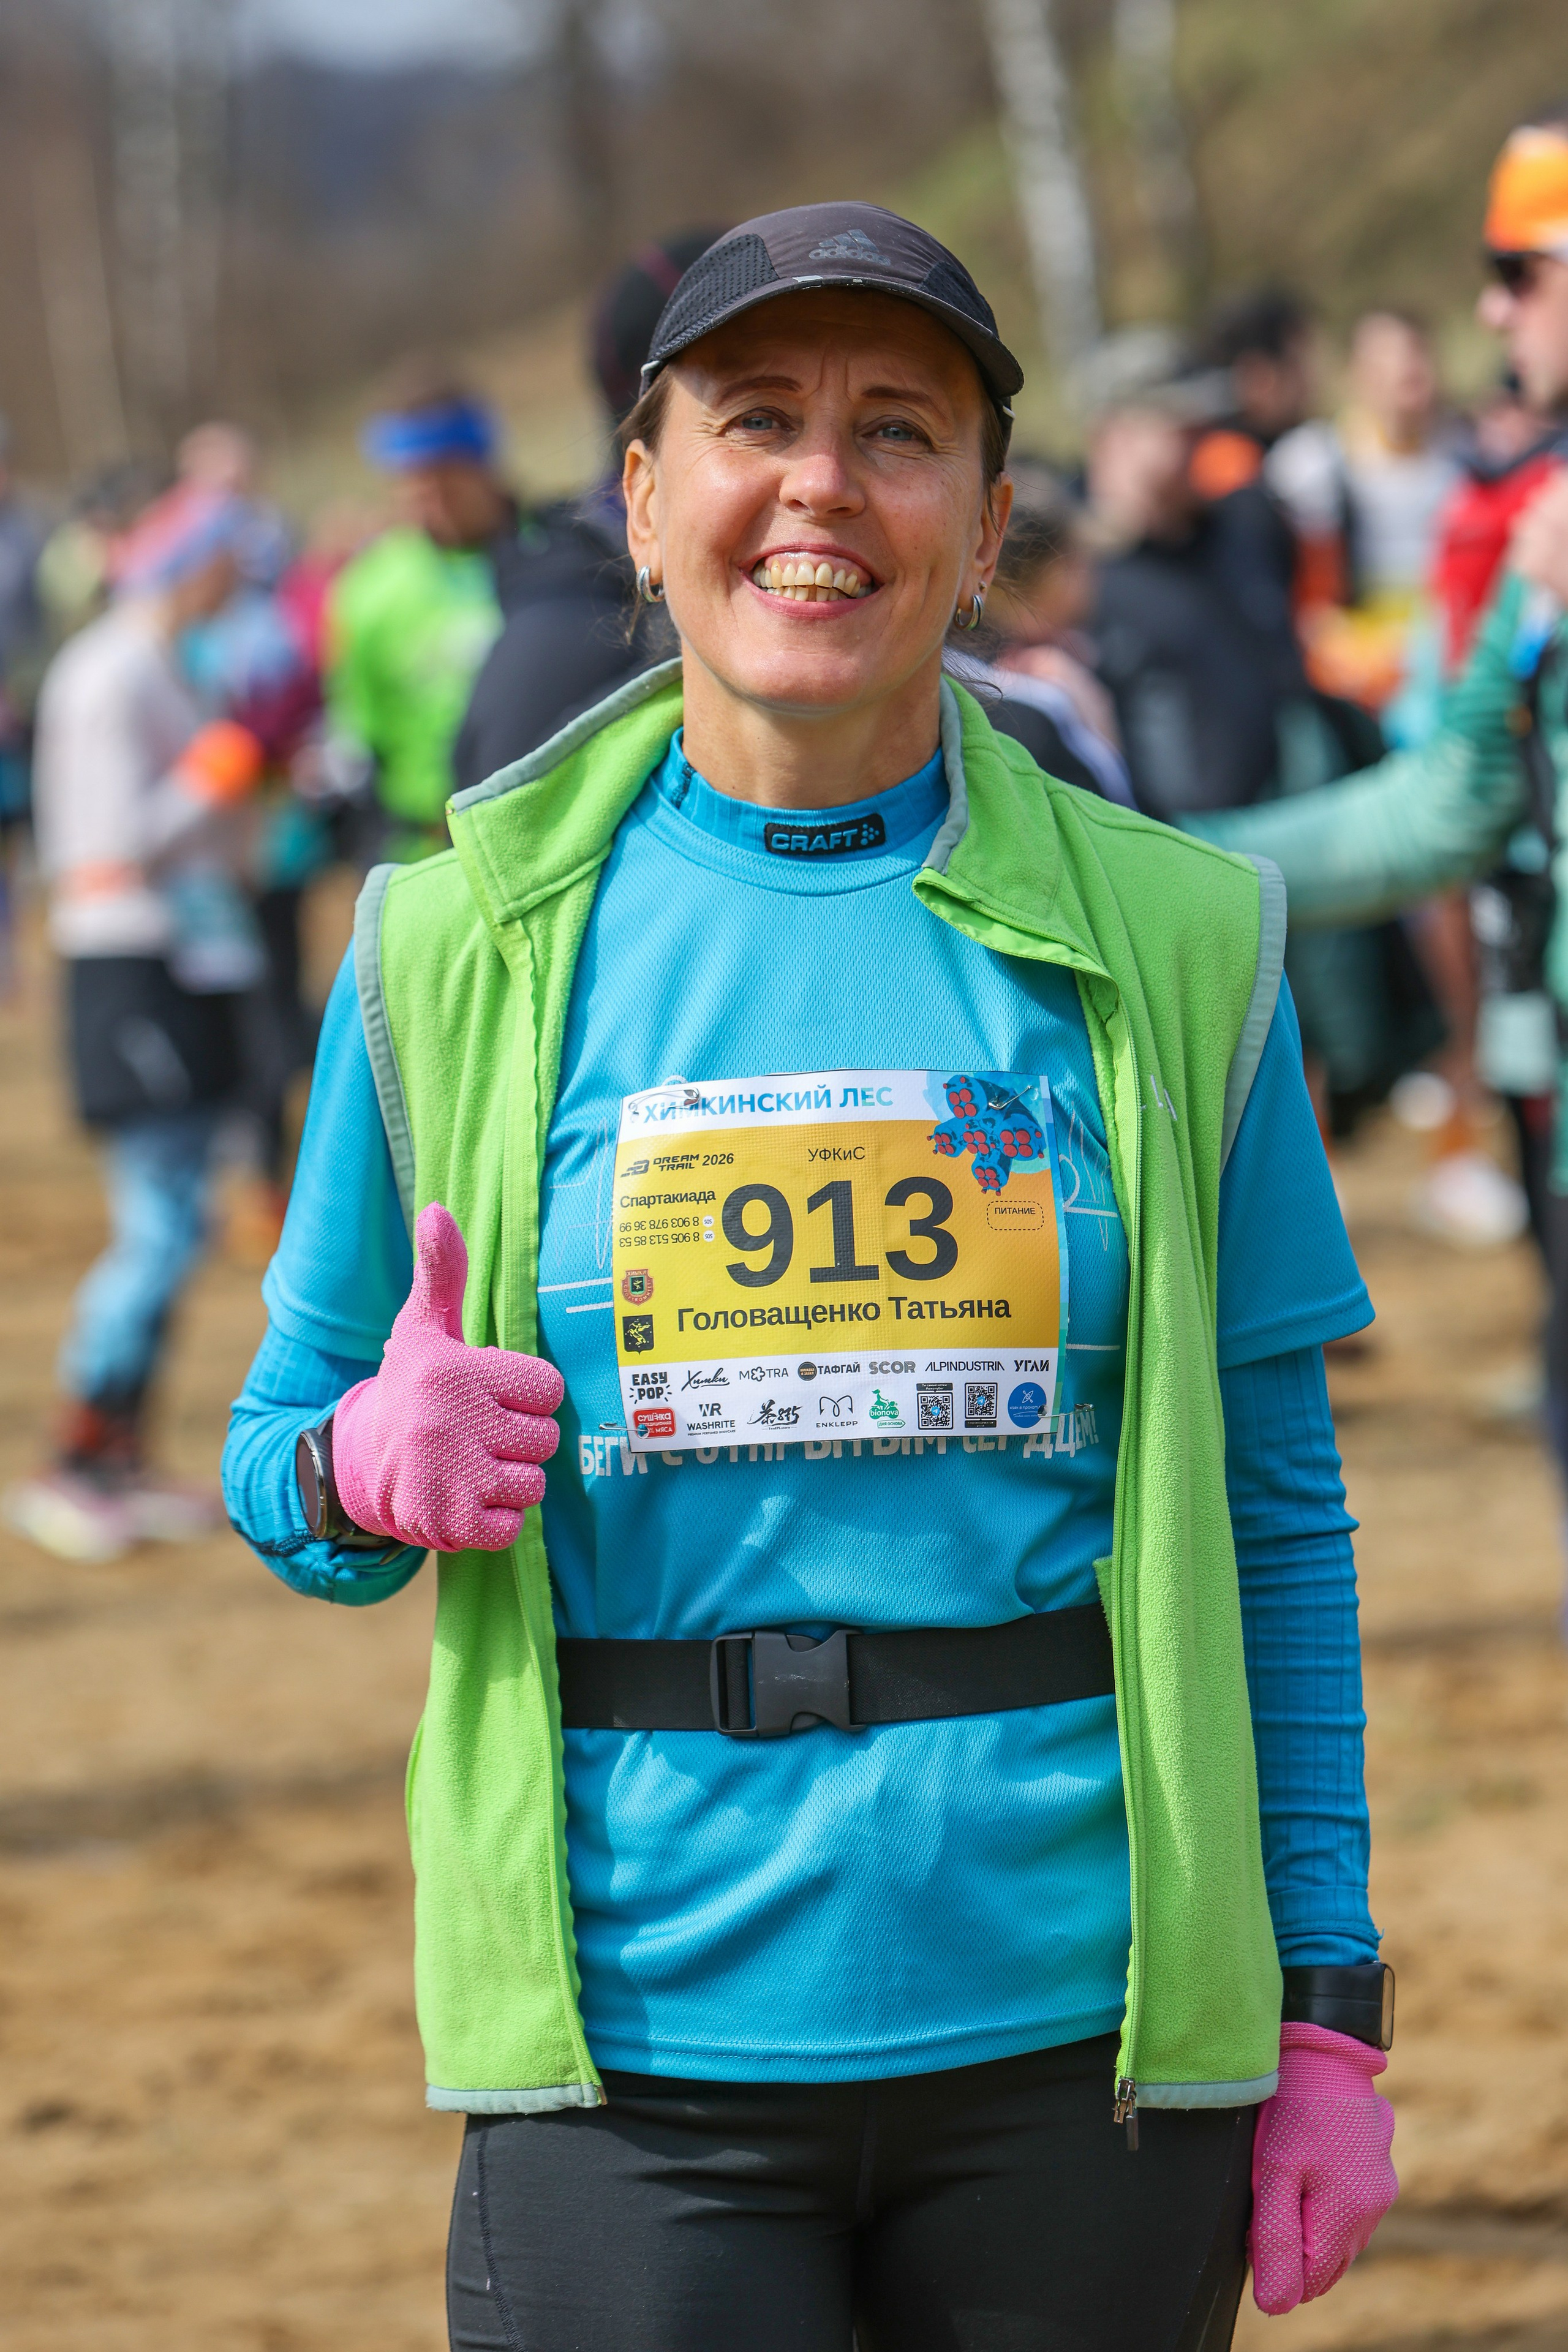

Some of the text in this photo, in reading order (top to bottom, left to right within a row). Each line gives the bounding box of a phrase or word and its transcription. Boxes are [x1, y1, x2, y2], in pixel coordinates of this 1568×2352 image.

[809, 244, 891, 266] adidas
[771, 829, 858, 851] CRAFT
[839, 1087, 894, 1107] ЛЕС
[653, 1153, 734, 1166] DREAM 2026
[808, 1146, 865, 1162] УФКиС
[658, 1163, 695, 1172] TRAIL
[620, 1190, 716, 1209] Спартакиада
[995, 1207, 1036, 1215] ПИТАНИЕ
[634, 1220, 647, 1231] 36
[649, 1219, 669, 1229] 978
[671, 1217, 690, 1228] 903
[692, 1216, 699, 1226] 8
[619, 1222, 631, 1232] 99
[722, 1176, 959, 1288] 913
[619, 1237, 631, 1247] 53
[634, 1235, 647, 1246] 85
[649, 1234, 669, 1245] 513
[671, 1232, 690, 1243] 905
[693, 1232, 699, 1242] 8
[677, 1297, 1012, 1332] Головащенко Татьяна
[818, 1362, 861, 1374] ТАФГАЙ
[869, 1360, 916, 1375] SCOR
[925, 1361, 1005, 1371] ALPINDUSTRIA
[1014, 1360, 1050, 1371] УГЛИ
[632, 1371, 668, 1386] EASY
[638, 1387, 664, 1400] POP
[687, 1420, 735, 1431] WASHRITE
[578, 1435, 648, 1476] БЕГИ
